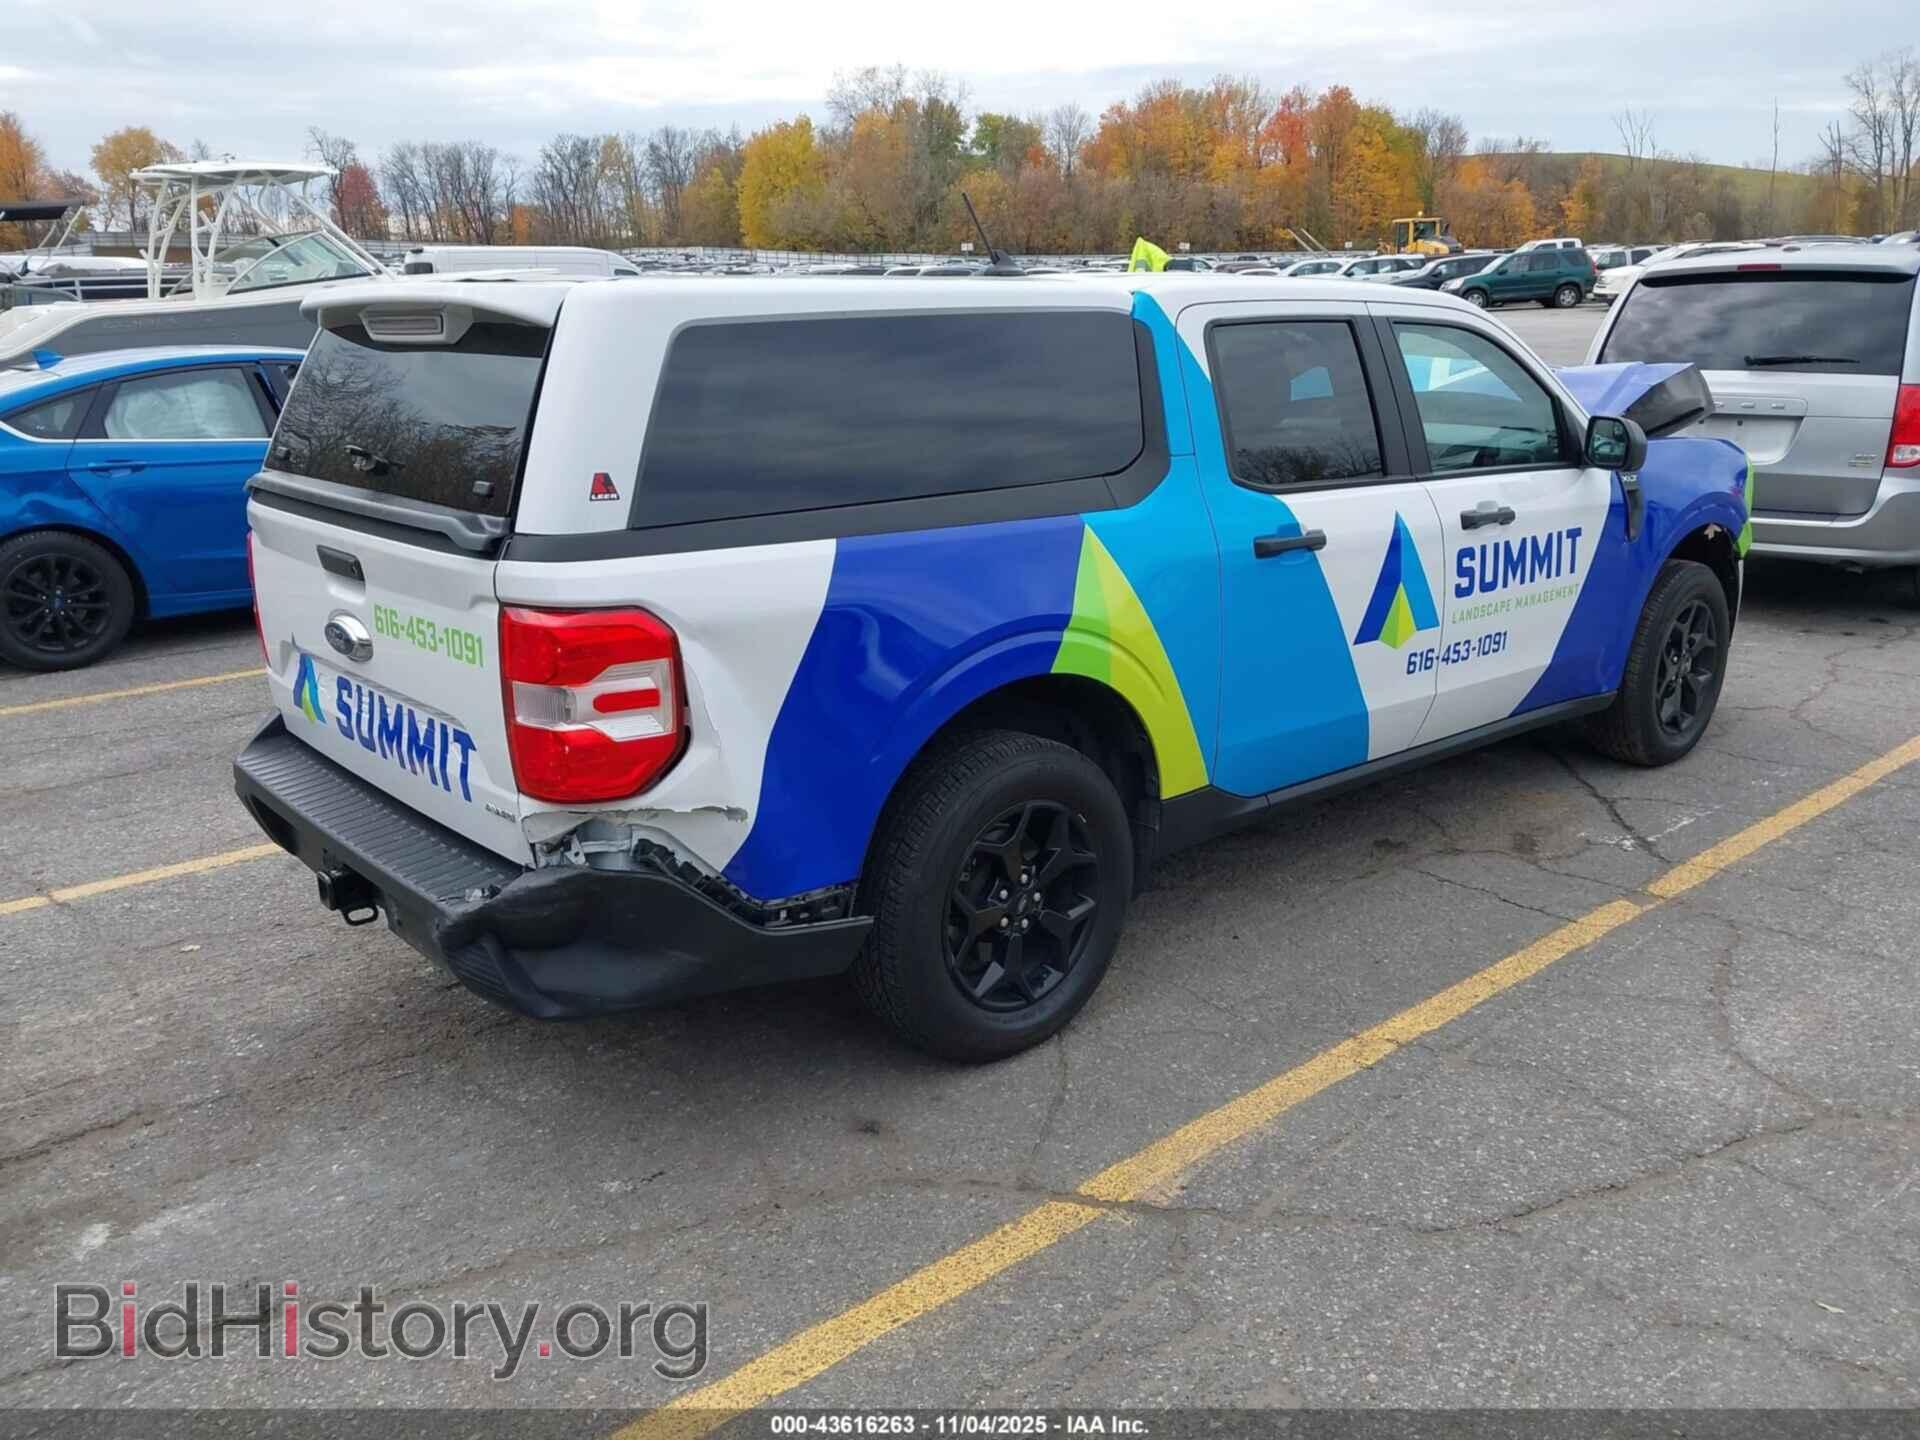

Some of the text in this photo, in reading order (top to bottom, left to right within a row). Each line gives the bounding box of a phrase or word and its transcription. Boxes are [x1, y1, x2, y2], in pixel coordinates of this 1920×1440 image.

[1455, 527, 1582, 598] SUMMIT
[1451, 583, 1580, 624] LANDSCAPE MANAGEMENT
[374, 604, 484, 668] 616-453-1091
[1406, 630, 1508, 675] 616-453-1091
[336, 675, 477, 803] SUMMIT
